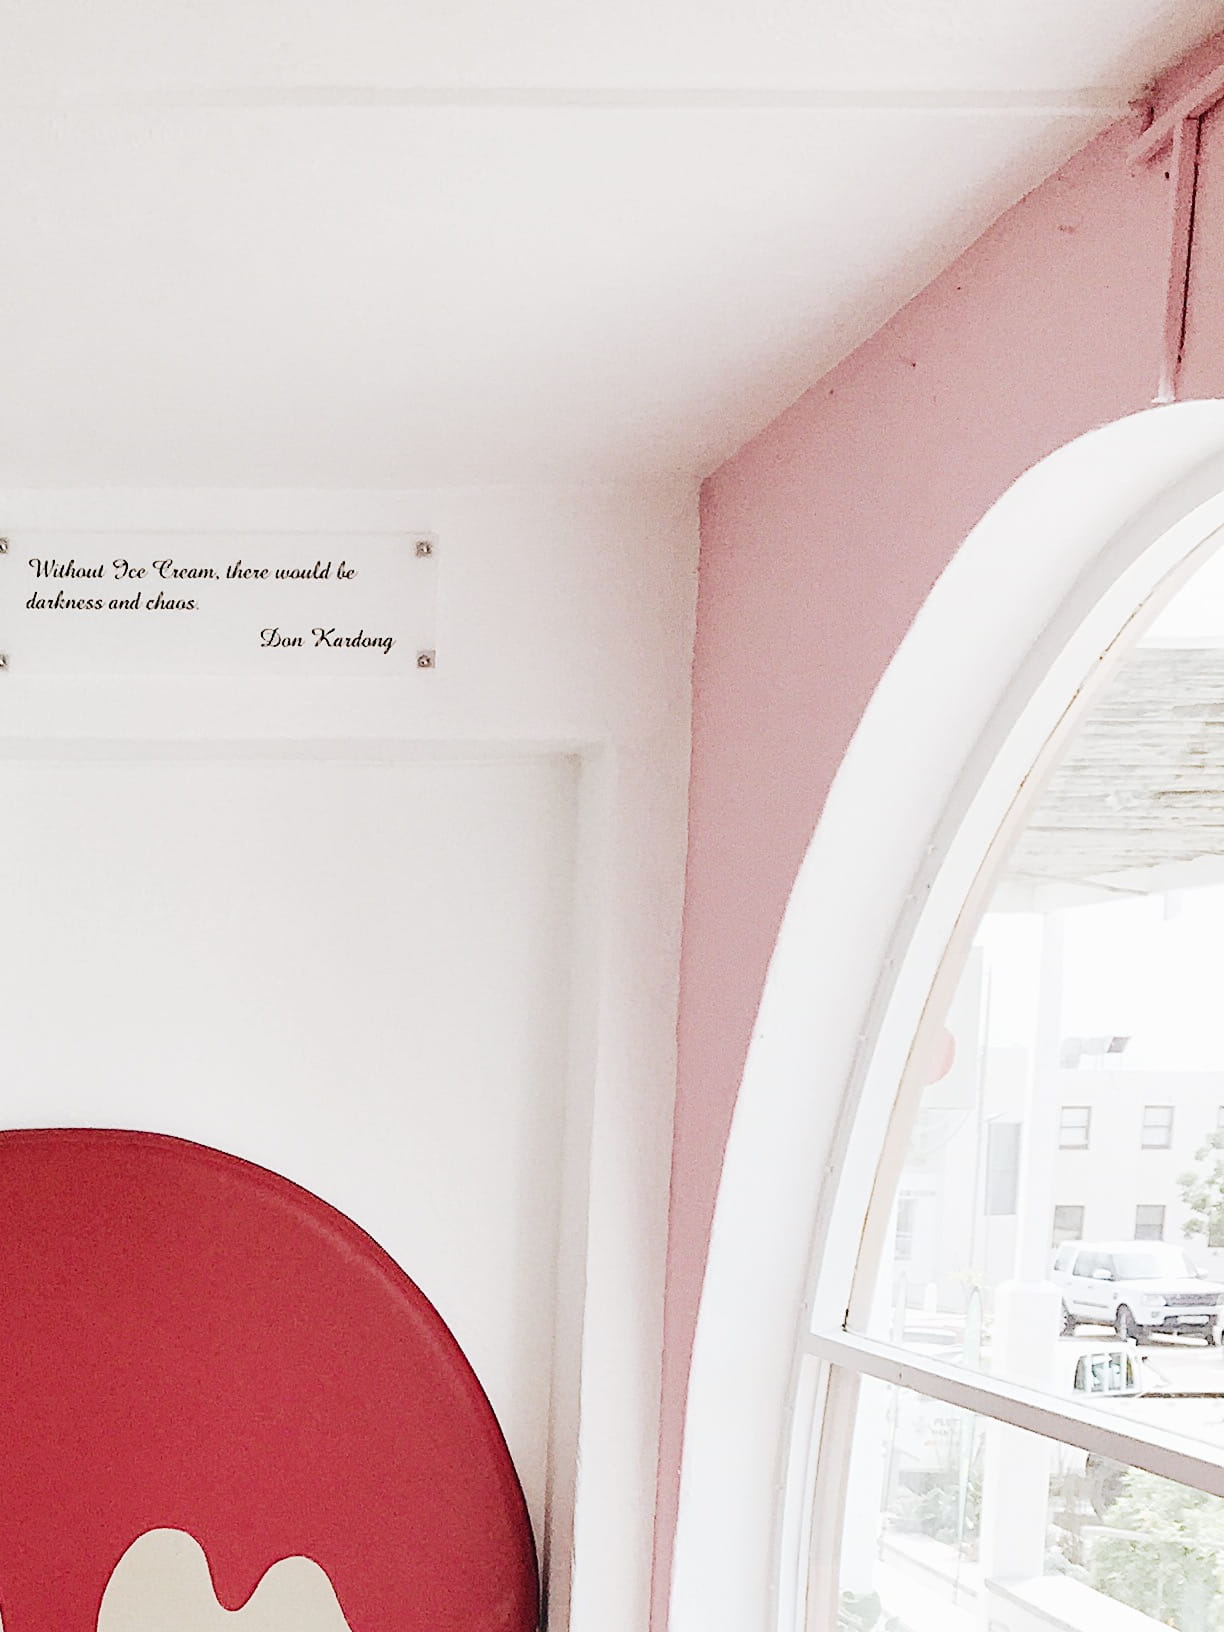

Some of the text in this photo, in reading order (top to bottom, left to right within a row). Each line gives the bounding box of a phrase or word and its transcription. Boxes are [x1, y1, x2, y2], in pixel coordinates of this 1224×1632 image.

[28, 558, 357, 581] Without Ice Cream, there would be
[25, 590, 200, 611] darkness and chaos.
[260, 627, 394, 655] Don Kardong
